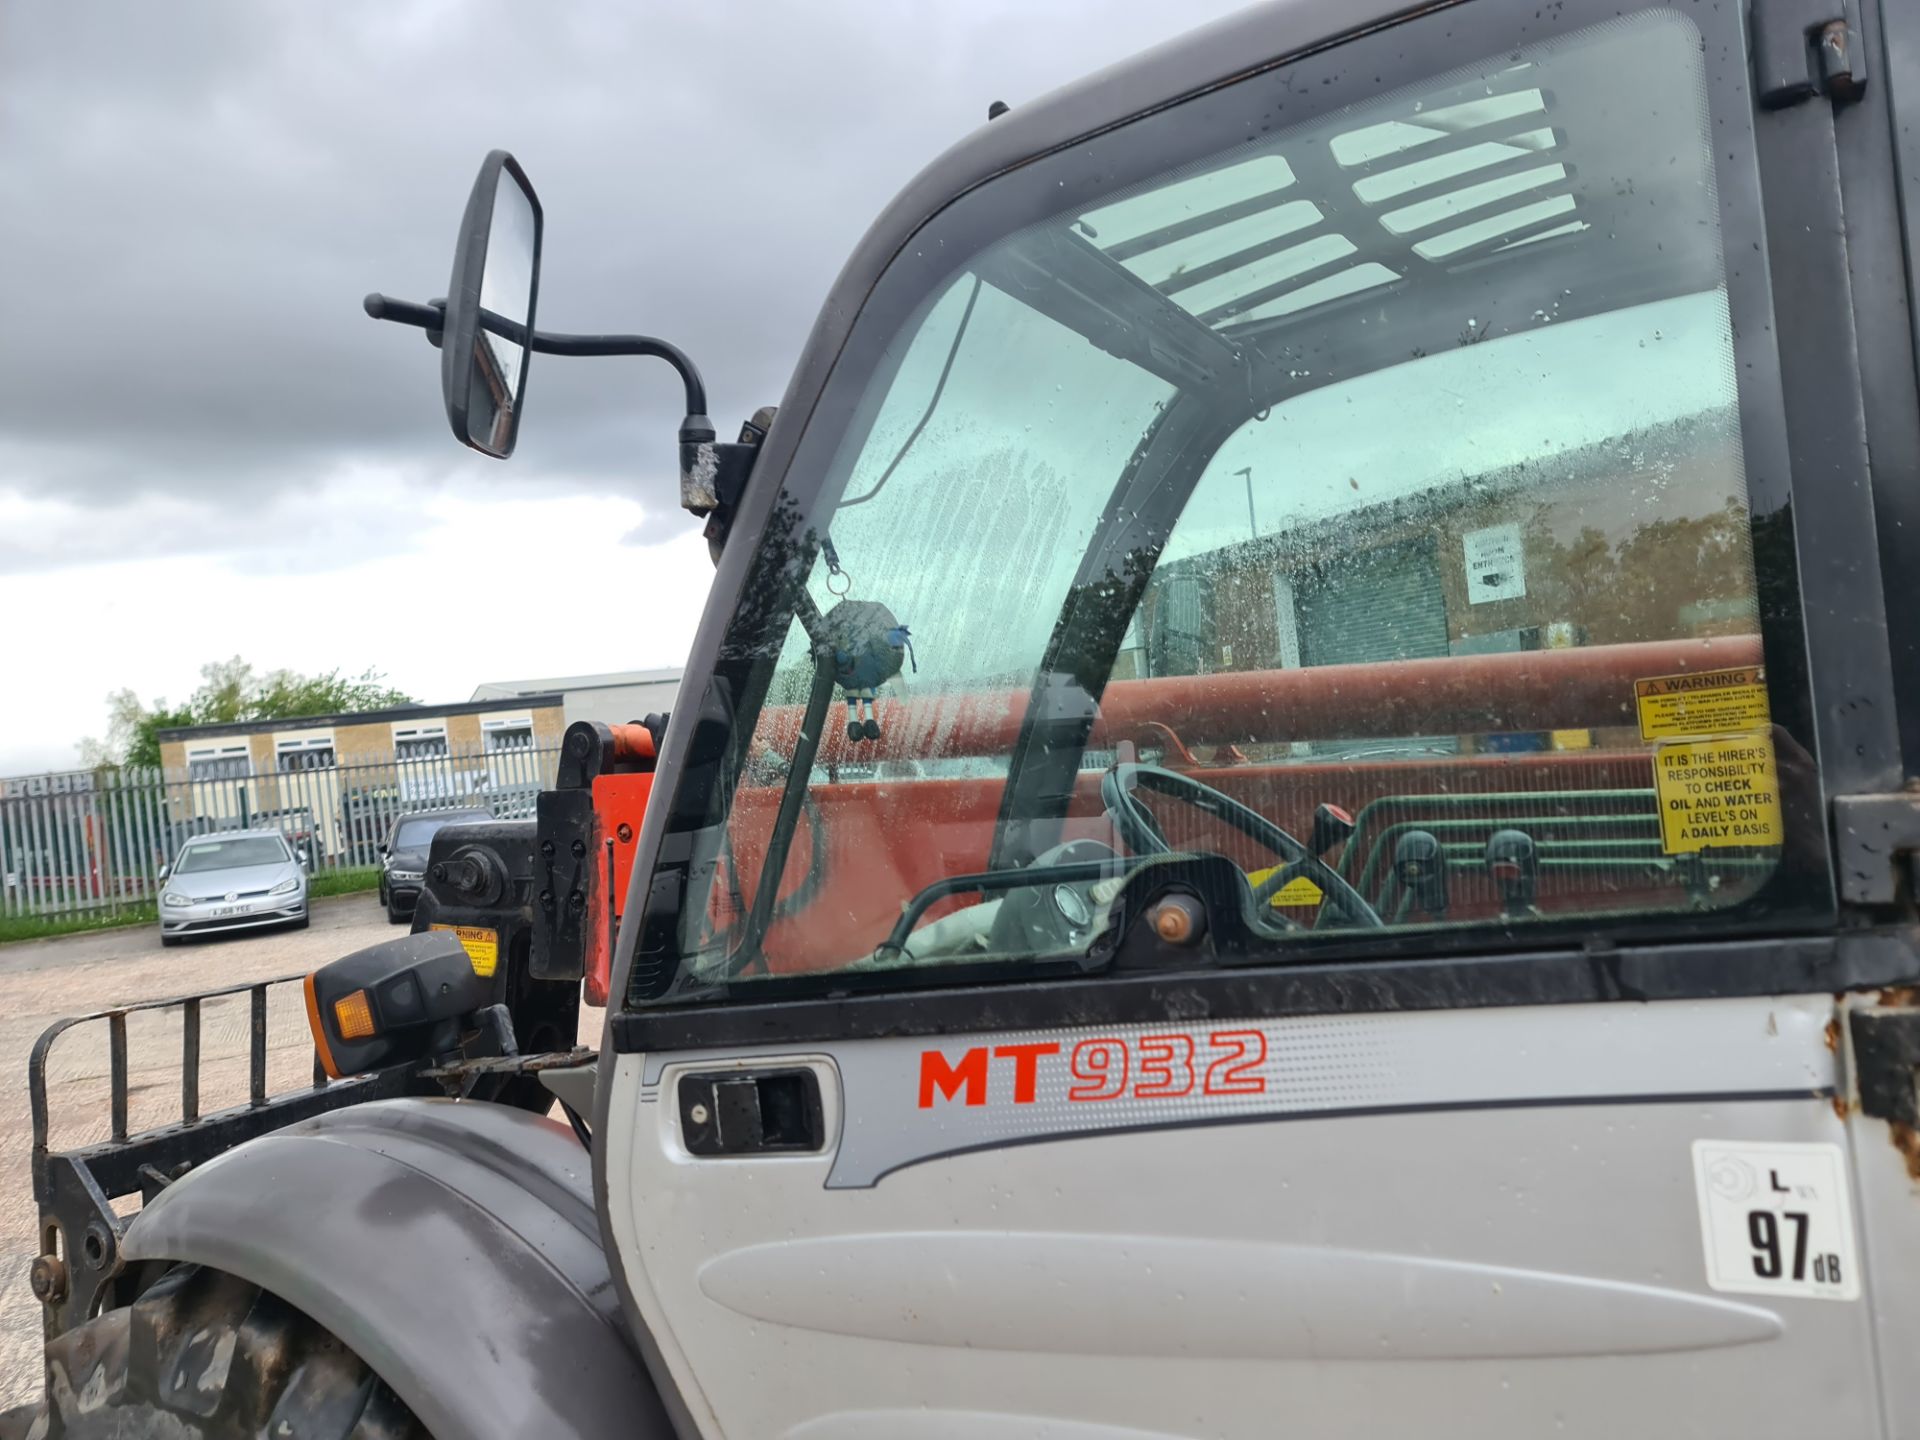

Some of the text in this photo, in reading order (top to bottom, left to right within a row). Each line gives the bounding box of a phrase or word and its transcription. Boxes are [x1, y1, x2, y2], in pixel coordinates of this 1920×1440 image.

[1665, 673, 1746, 690] WARNING
[1664, 747, 1766, 767] IT IS THE HIRER'S
[1668, 762, 1766, 781] RESPONSIBILITY
[1685, 779, 1752, 794] TO CHECK
[1670, 793, 1773, 810] OIL AND WATER
[1687, 809, 1758, 824] LEVEL'S ON
[1681, 822, 1770, 840] A DAILY BASIS
[1770, 1168, 1791, 1193] L
